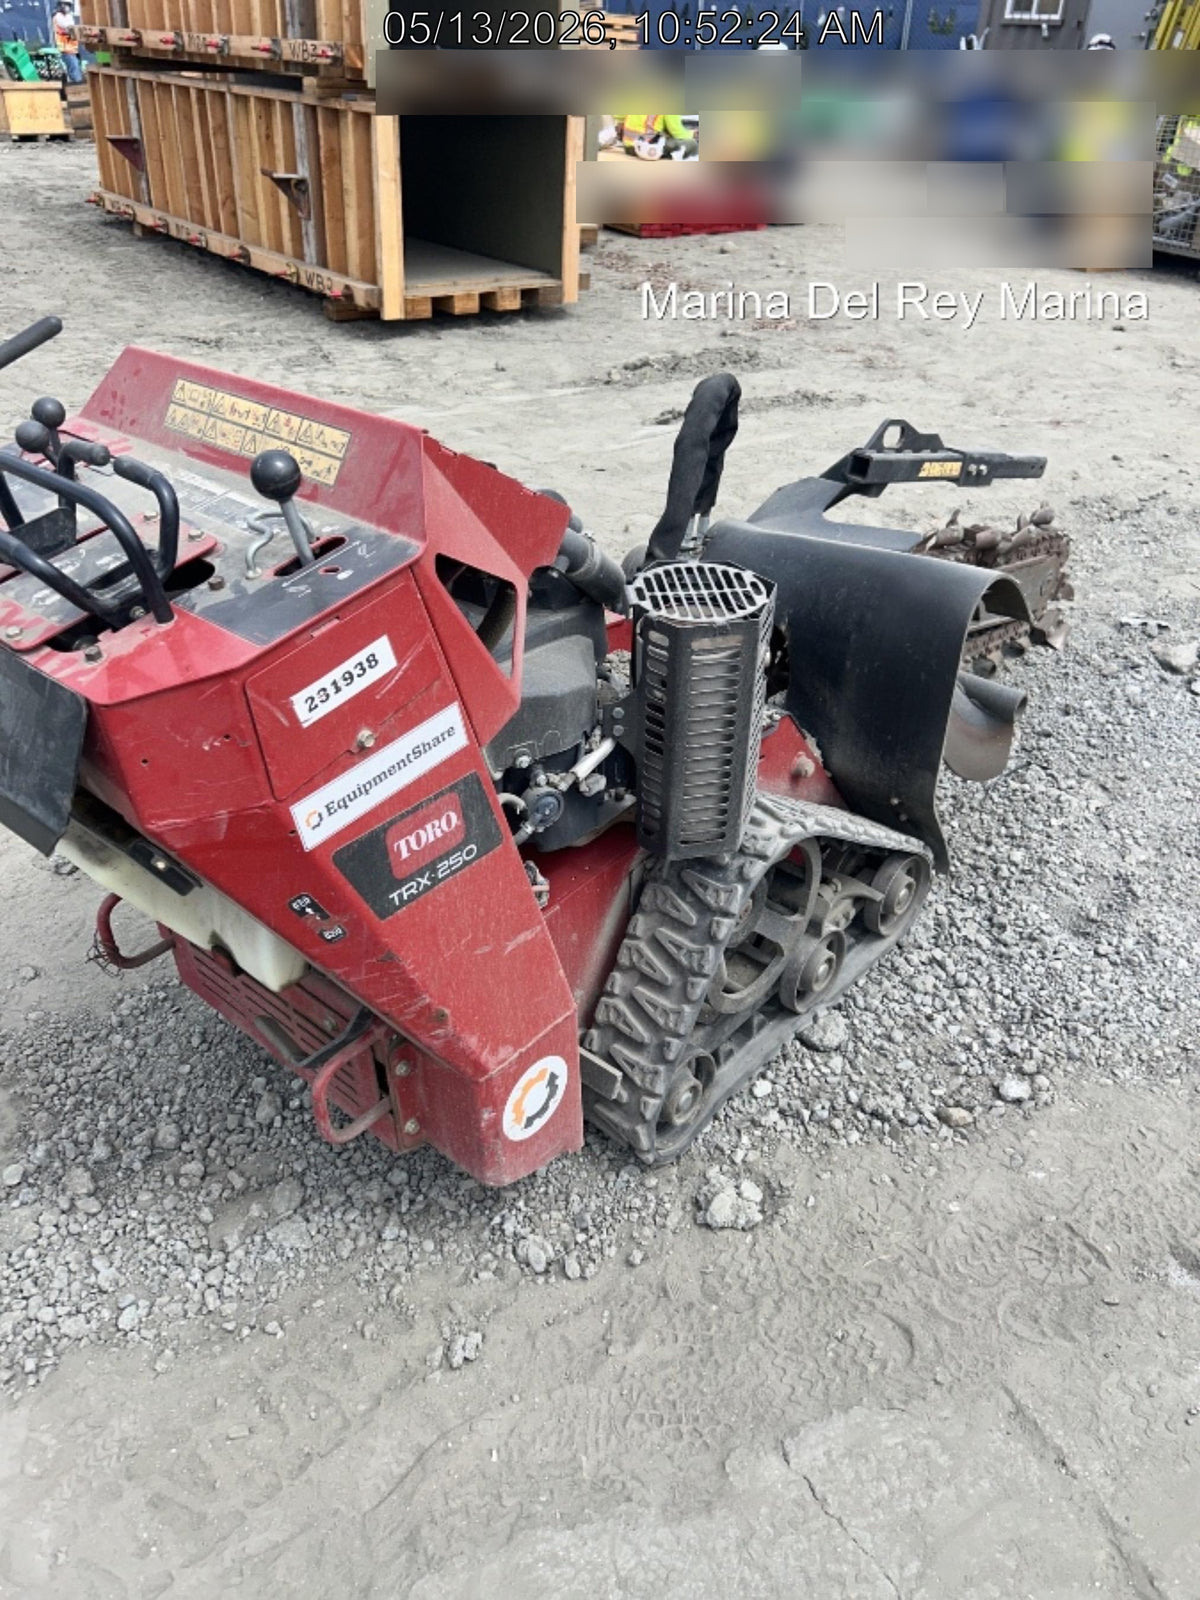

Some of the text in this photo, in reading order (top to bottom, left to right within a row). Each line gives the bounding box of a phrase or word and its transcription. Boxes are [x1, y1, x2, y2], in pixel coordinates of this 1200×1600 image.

[304, 653, 379, 713] 231938
[325, 725, 456, 817] EquipmentShare
[393, 811, 458, 861] TORO
